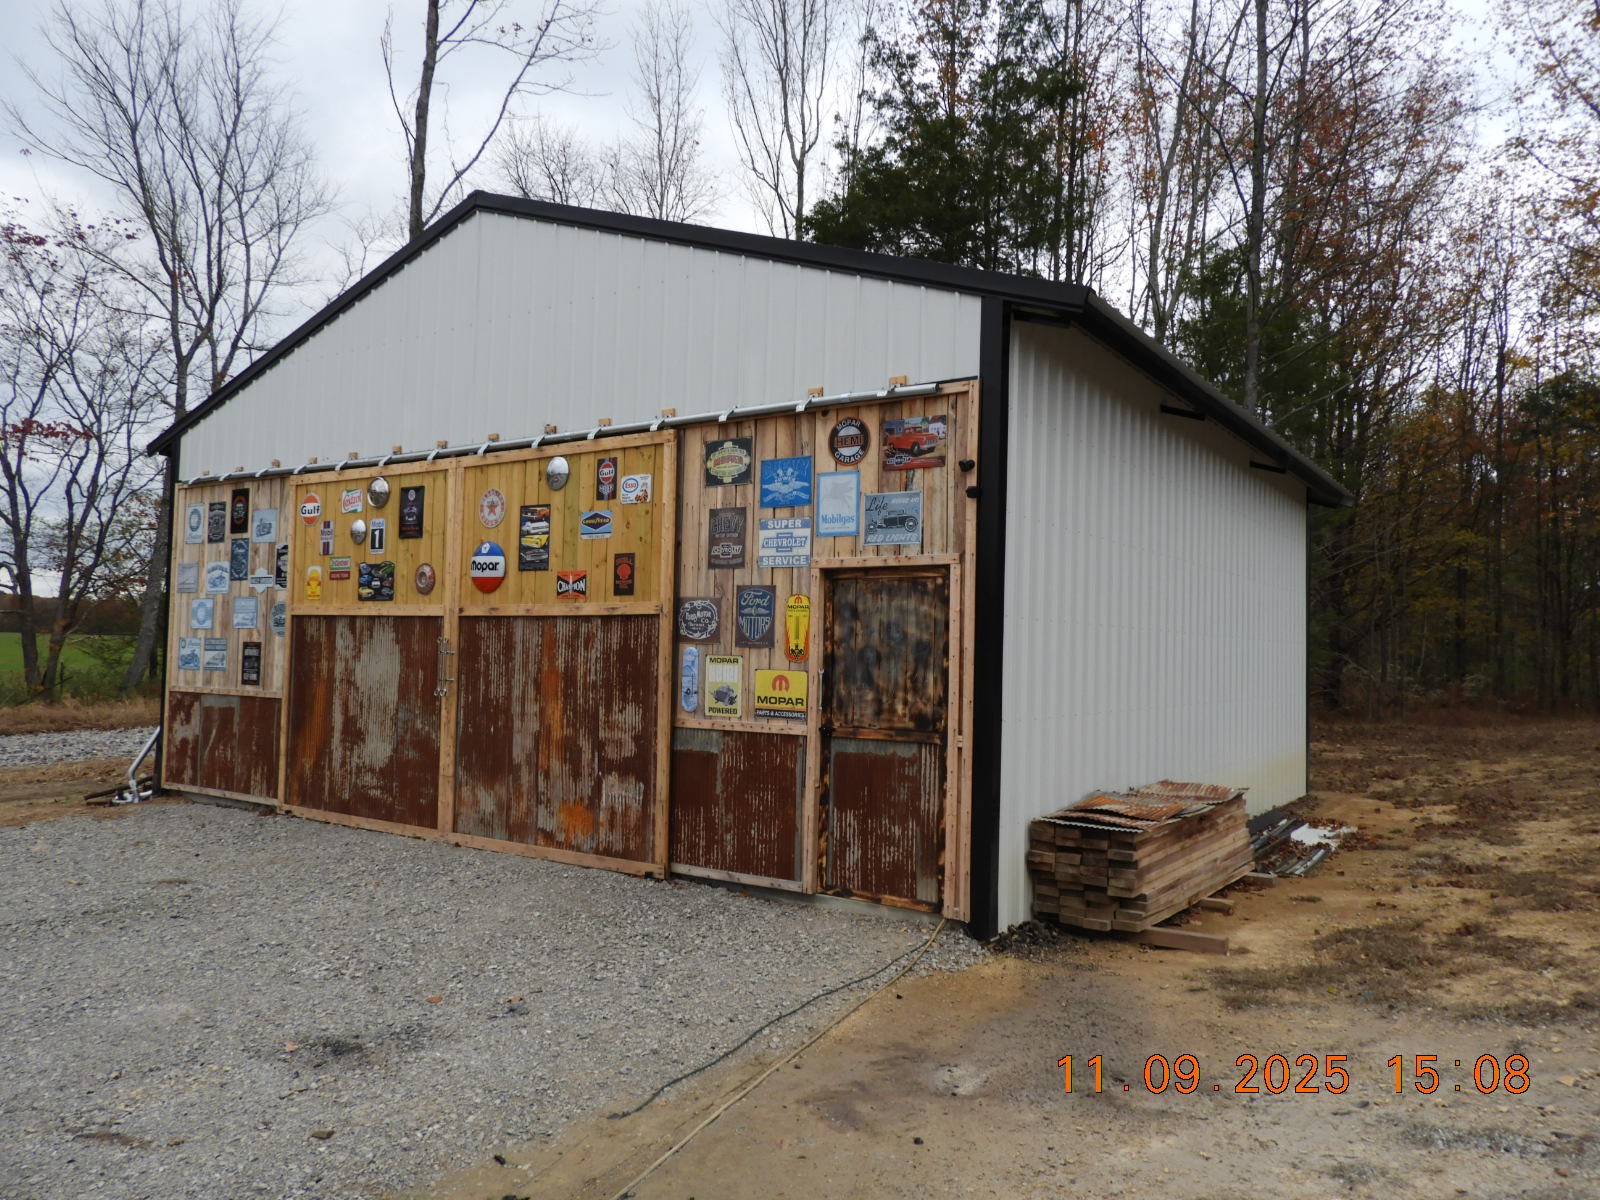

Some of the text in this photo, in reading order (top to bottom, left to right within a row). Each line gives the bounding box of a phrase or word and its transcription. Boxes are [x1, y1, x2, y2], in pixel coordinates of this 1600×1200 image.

[837, 419, 861, 432] MOPAR
[835, 435, 866, 449] HEMI
[834, 449, 865, 463] GARAGE
[301, 505, 320, 515] Gulf
[767, 519, 802, 529] SUPER
[821, 513, 856, 526] Mobilgas
[374, 529, 380, 549] 1
[763, 537, 807, 548] CHEVROLET
[471, 559, 500, 573] Mopar
[762, 555, 807, 566] SERVICE
[557, 578, 586, 593] CHAION
[741, 591, 770, 607] Ford
[739, 616, 771, 639] MOTORS
[756, 695, 804, 707] MOPAR
[708, 706, 738, 715] POWERED
